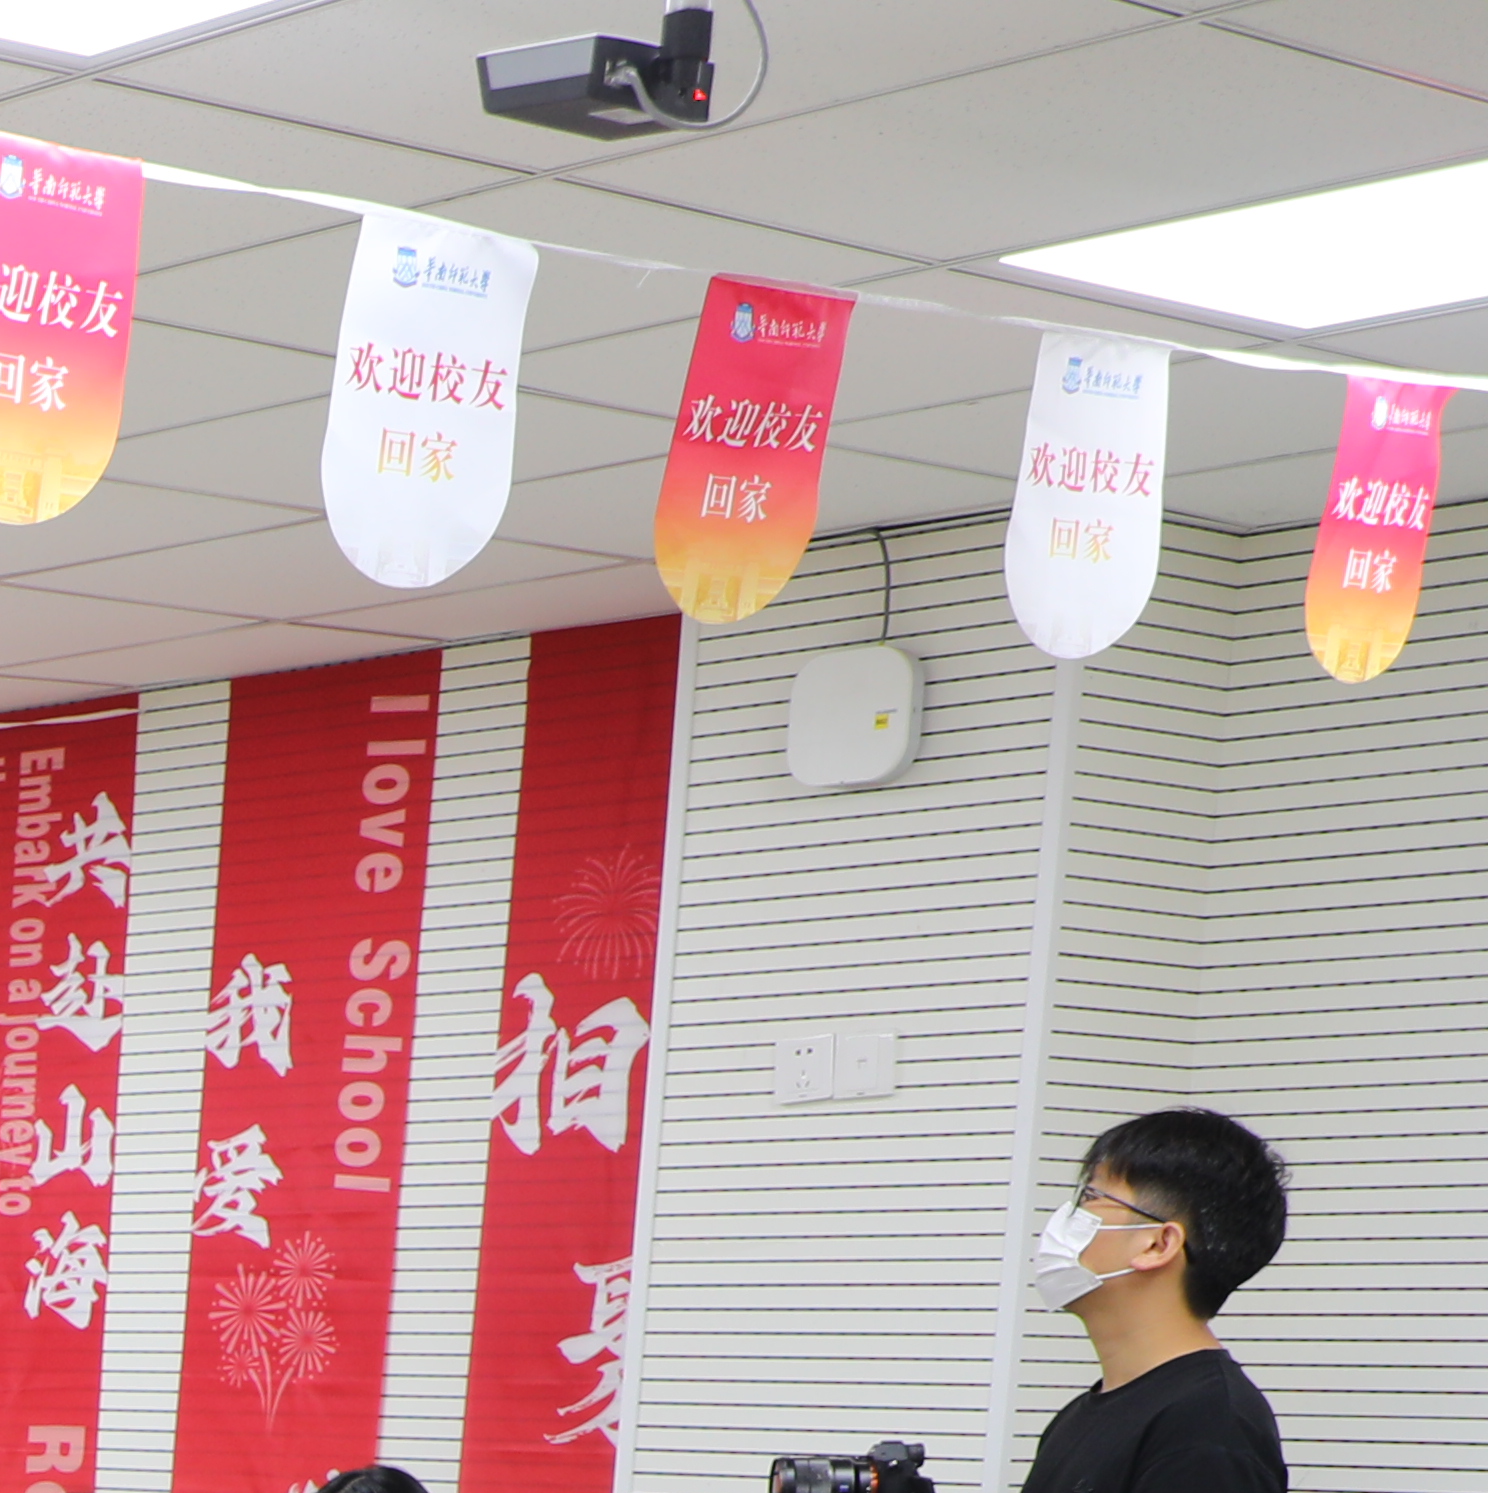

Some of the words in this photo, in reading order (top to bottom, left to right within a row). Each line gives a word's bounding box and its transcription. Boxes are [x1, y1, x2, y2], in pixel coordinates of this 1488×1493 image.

[345, 341, 509, 411] 欢迎校友
[682, 393, 824, 453] 欢迎校友
[376, 426, 459, 483] 回家
[1026, 442, 1156, 499] 欢迎校友
[700, 472, 773, 524] 回家
[1331, 475, 1432, 531] 欢迎校友
[1048, 517, 1115, 564] 回家
[1342, 547, 1398, 593] 回家
[369, 693, 431, 715] I
[12, 747, 66, 908] Embark
[353, 739, 428, 894] love
[9, 917, 45, 968] on
[8, 978, 43, 1003] a
[23, 792, 133, 1330] 共赴山海
[333, 938, 413, 1194] School
